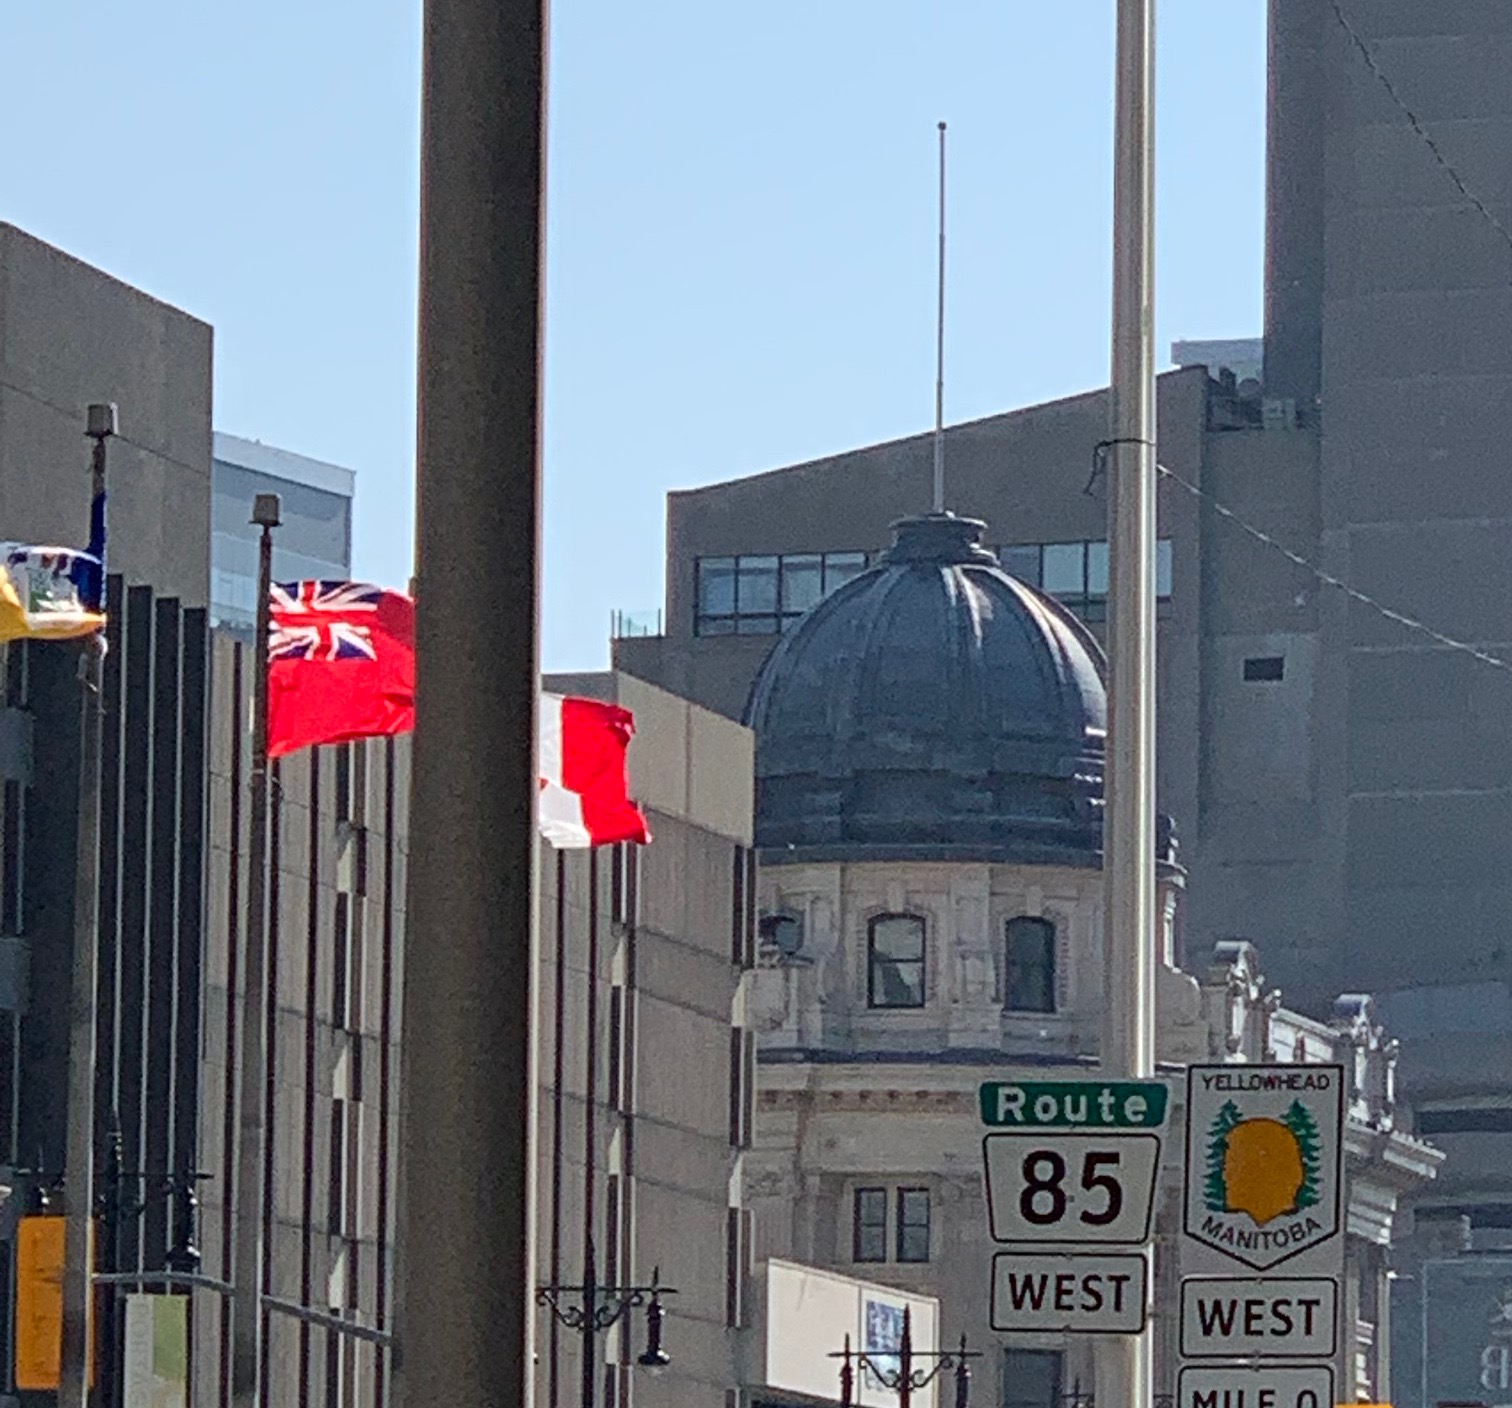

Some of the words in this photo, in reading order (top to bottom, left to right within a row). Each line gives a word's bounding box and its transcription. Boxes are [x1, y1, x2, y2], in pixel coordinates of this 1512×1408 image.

[1202, 1073, 1331, 1092] YELLOWHEAD
[996, 1086, 1148, 1123] Route
[1019, 1151, 1122, 1226] 85
[1202, 1216, 1323, 1251] MANITOBA
[1008, 1274, 1131, 1313] WEST
[1199, 1299, 1321, 1337] WEST
